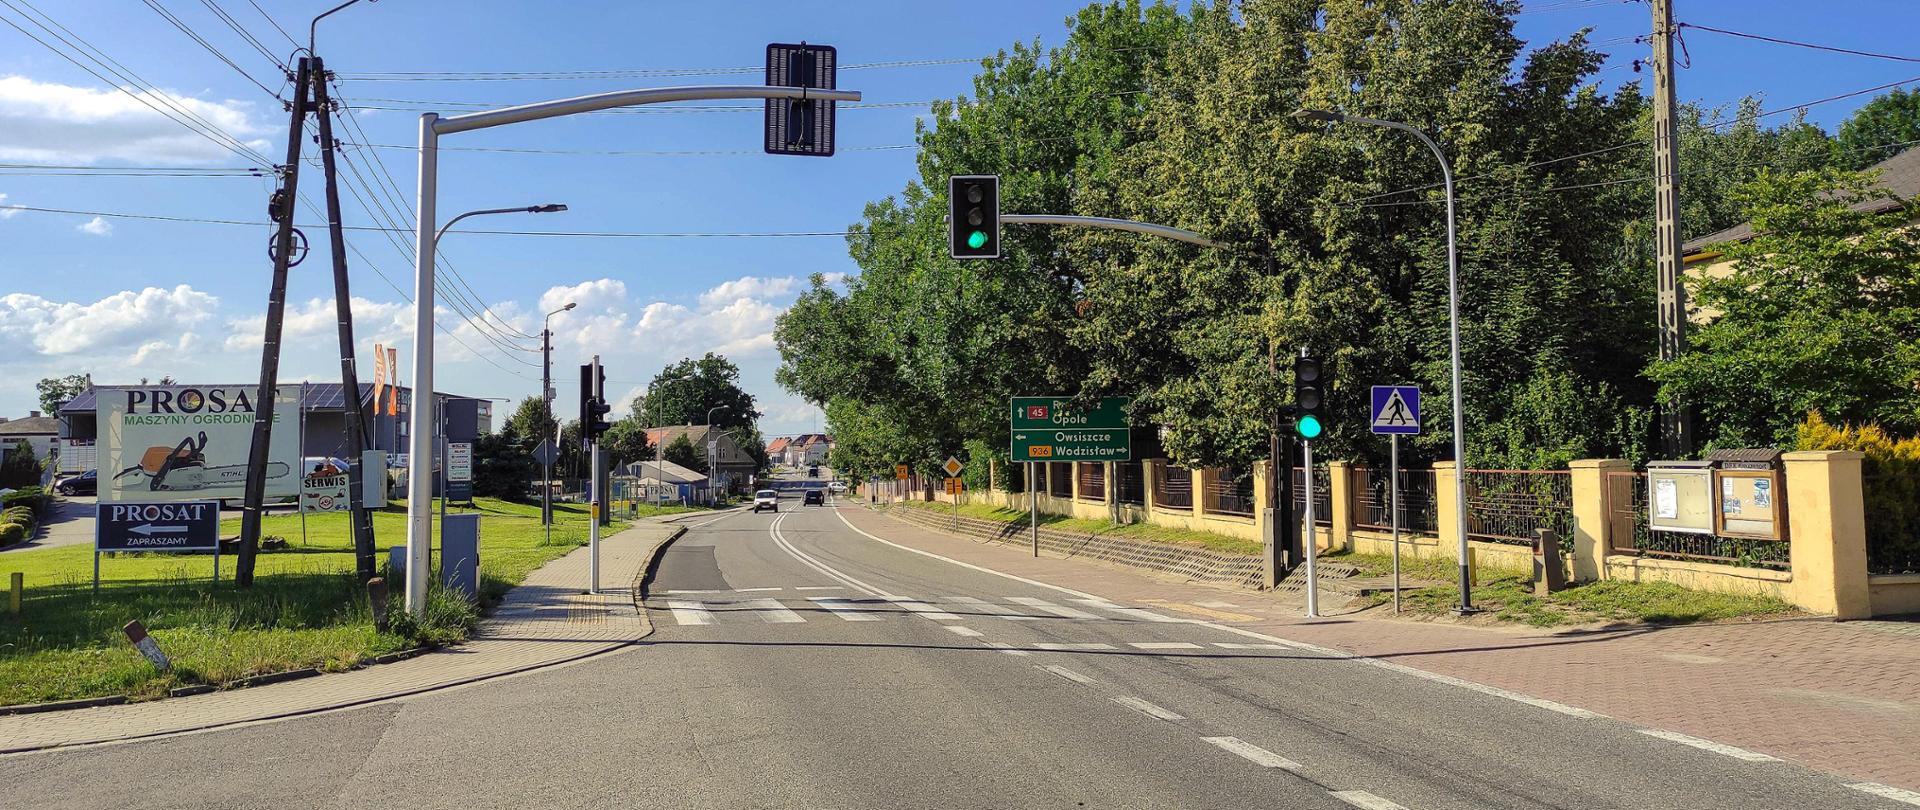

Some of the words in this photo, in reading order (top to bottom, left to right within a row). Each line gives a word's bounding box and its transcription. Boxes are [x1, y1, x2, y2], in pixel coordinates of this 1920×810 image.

[1032, 408, 1043, 417] 45
[124, 414, 189, 426] MASZYNY
[192, 413, 280, 424] OGRODNIE
[1052, 414, 1088, 427] Opole
[1055, 432, 1111, 442] Owsiszcze
[1032, 447, 1049, 455] 936
[1055, 445, 1115, 456] Wodzisław
[304, 476, 346, 488] SERWIS
[111, 504, 206, 522] PROSAT
[127, 537, 188, 546] ZAPRASZAMY
